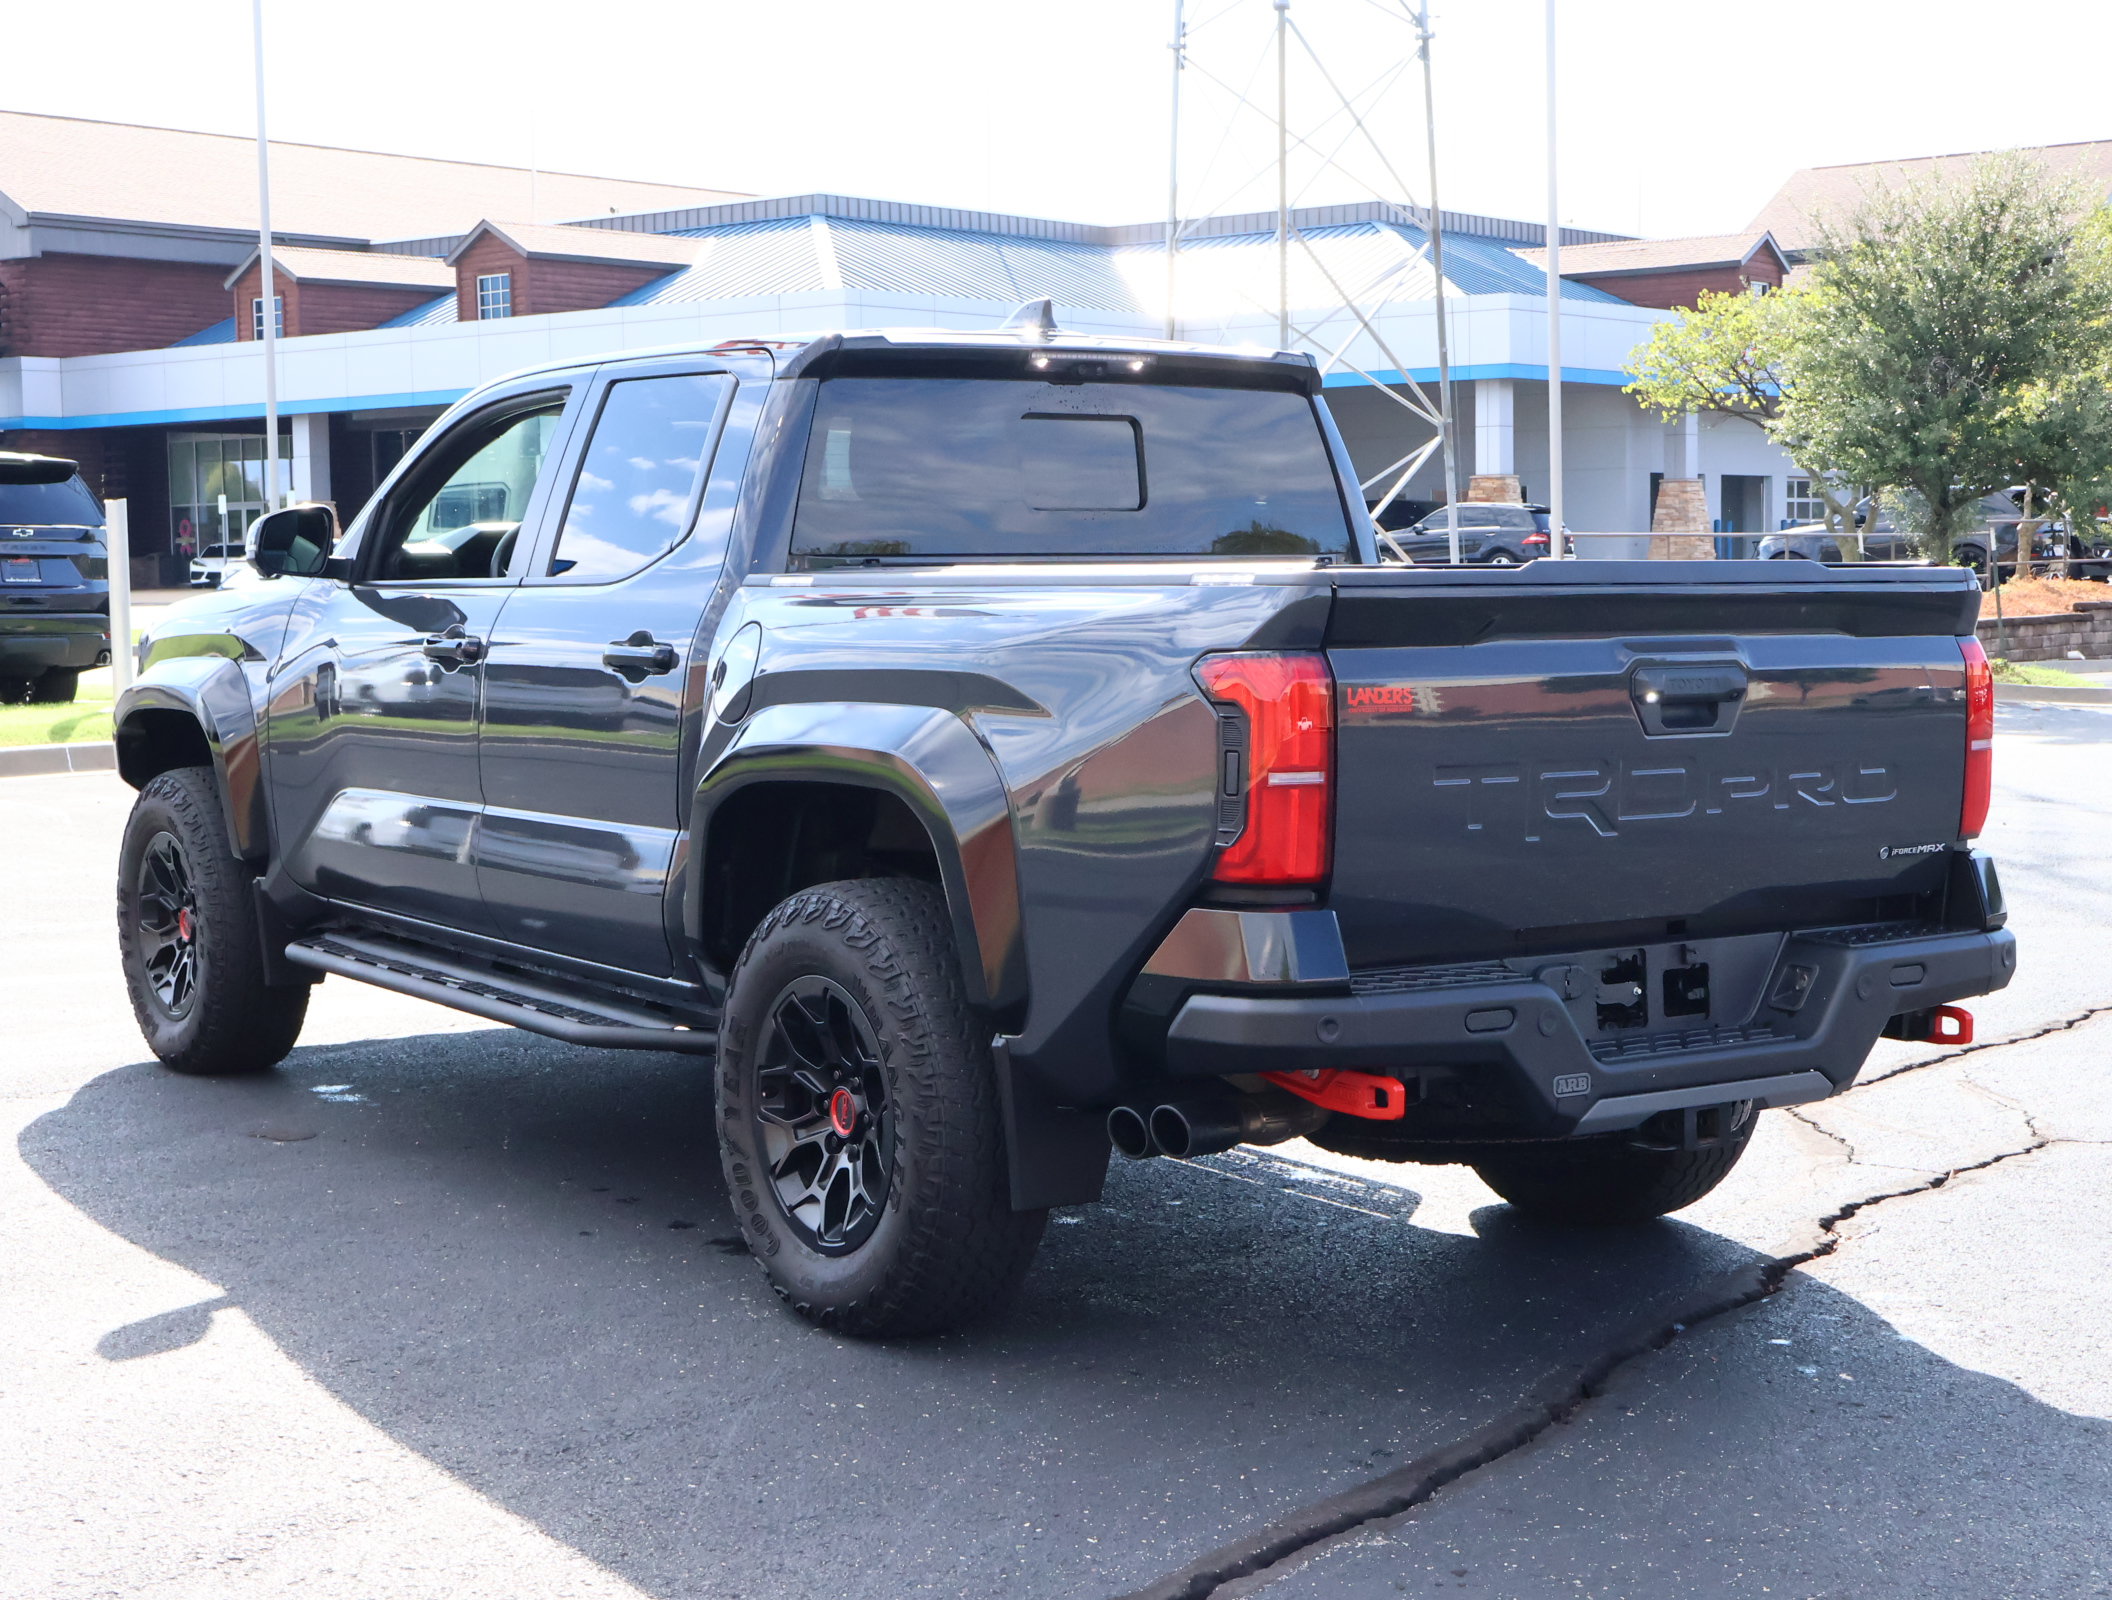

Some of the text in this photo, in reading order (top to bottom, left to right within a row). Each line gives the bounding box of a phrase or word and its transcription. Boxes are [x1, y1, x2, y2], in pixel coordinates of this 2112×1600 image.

[1347, 687, 1413, 706] LANDERS
[1434, 757, 1897, 841] TRD PRO
[1557, 1077, 1588, 1094] ARB
